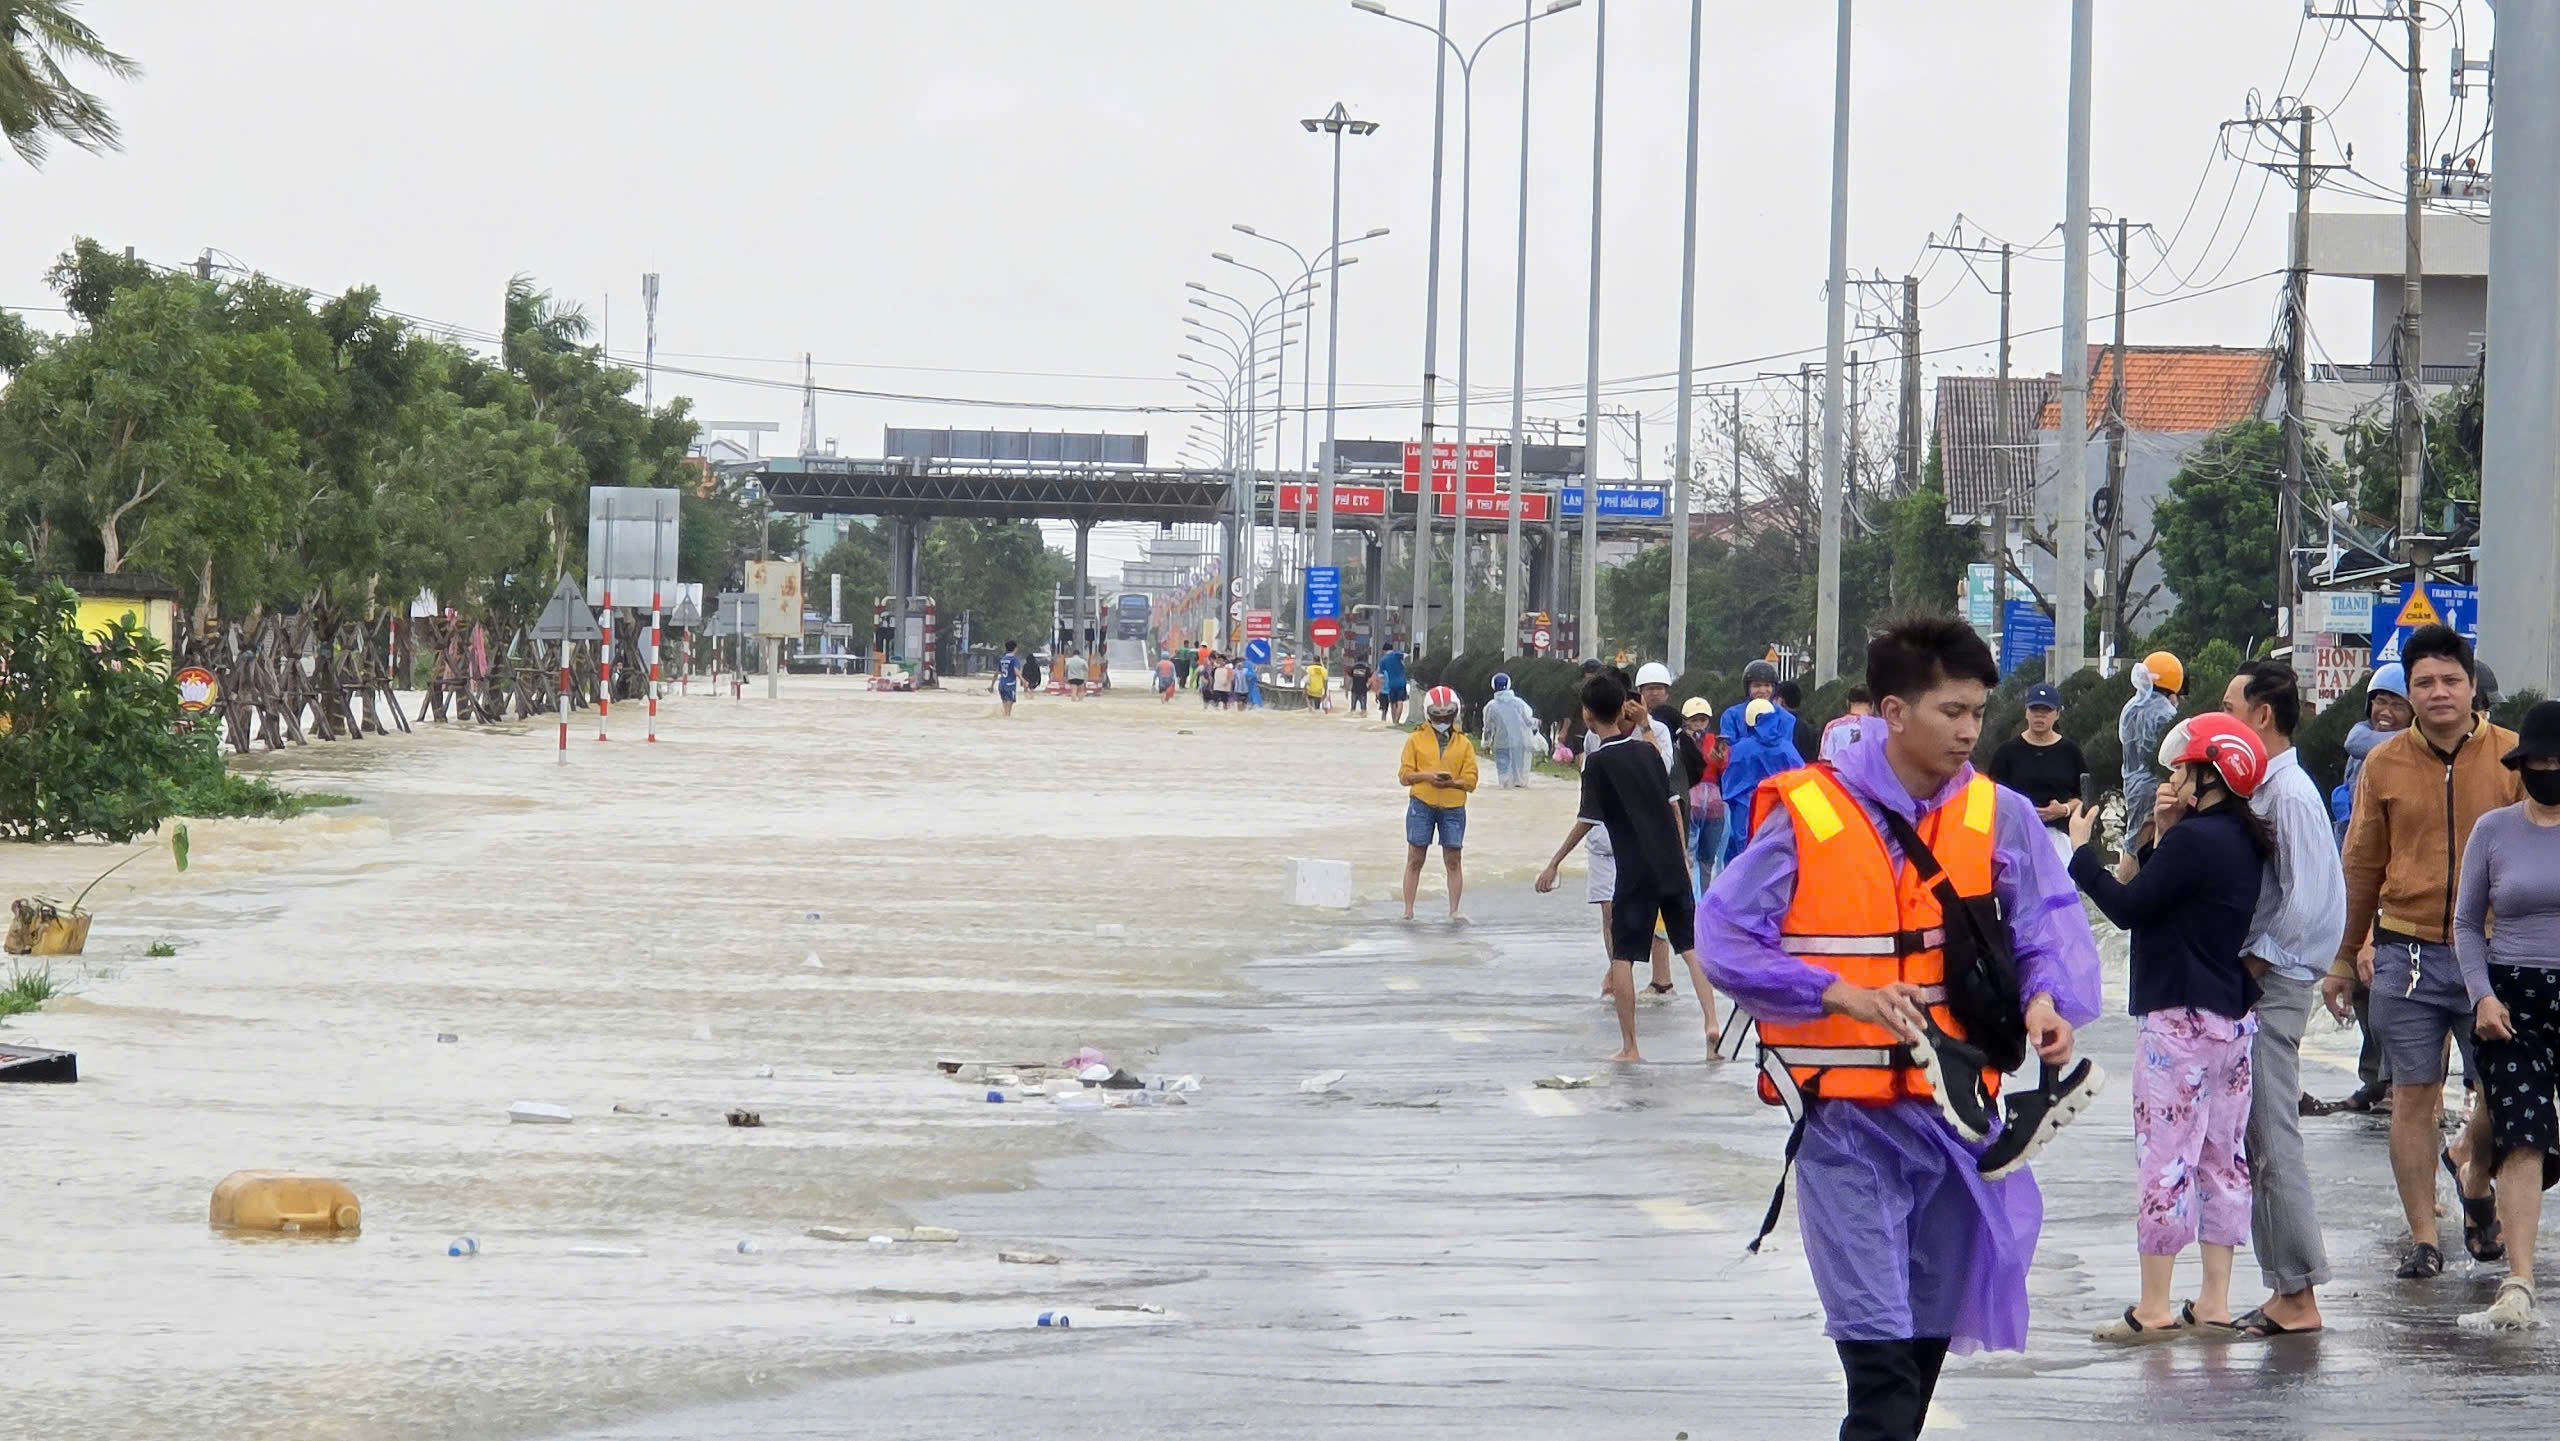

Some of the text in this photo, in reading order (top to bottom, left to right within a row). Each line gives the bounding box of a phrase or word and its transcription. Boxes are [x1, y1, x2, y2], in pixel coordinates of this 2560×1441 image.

[1352, 495, 1370, 506] ETC
[1563, 493, 1582, 506] LÀN
[1603, 494, 1619, 508] PHÍ
[2330, 596, 2369, 611] THANH
[2317, 648, 2357, 668] HON
[2317, 669, 2355, 688] TAY
